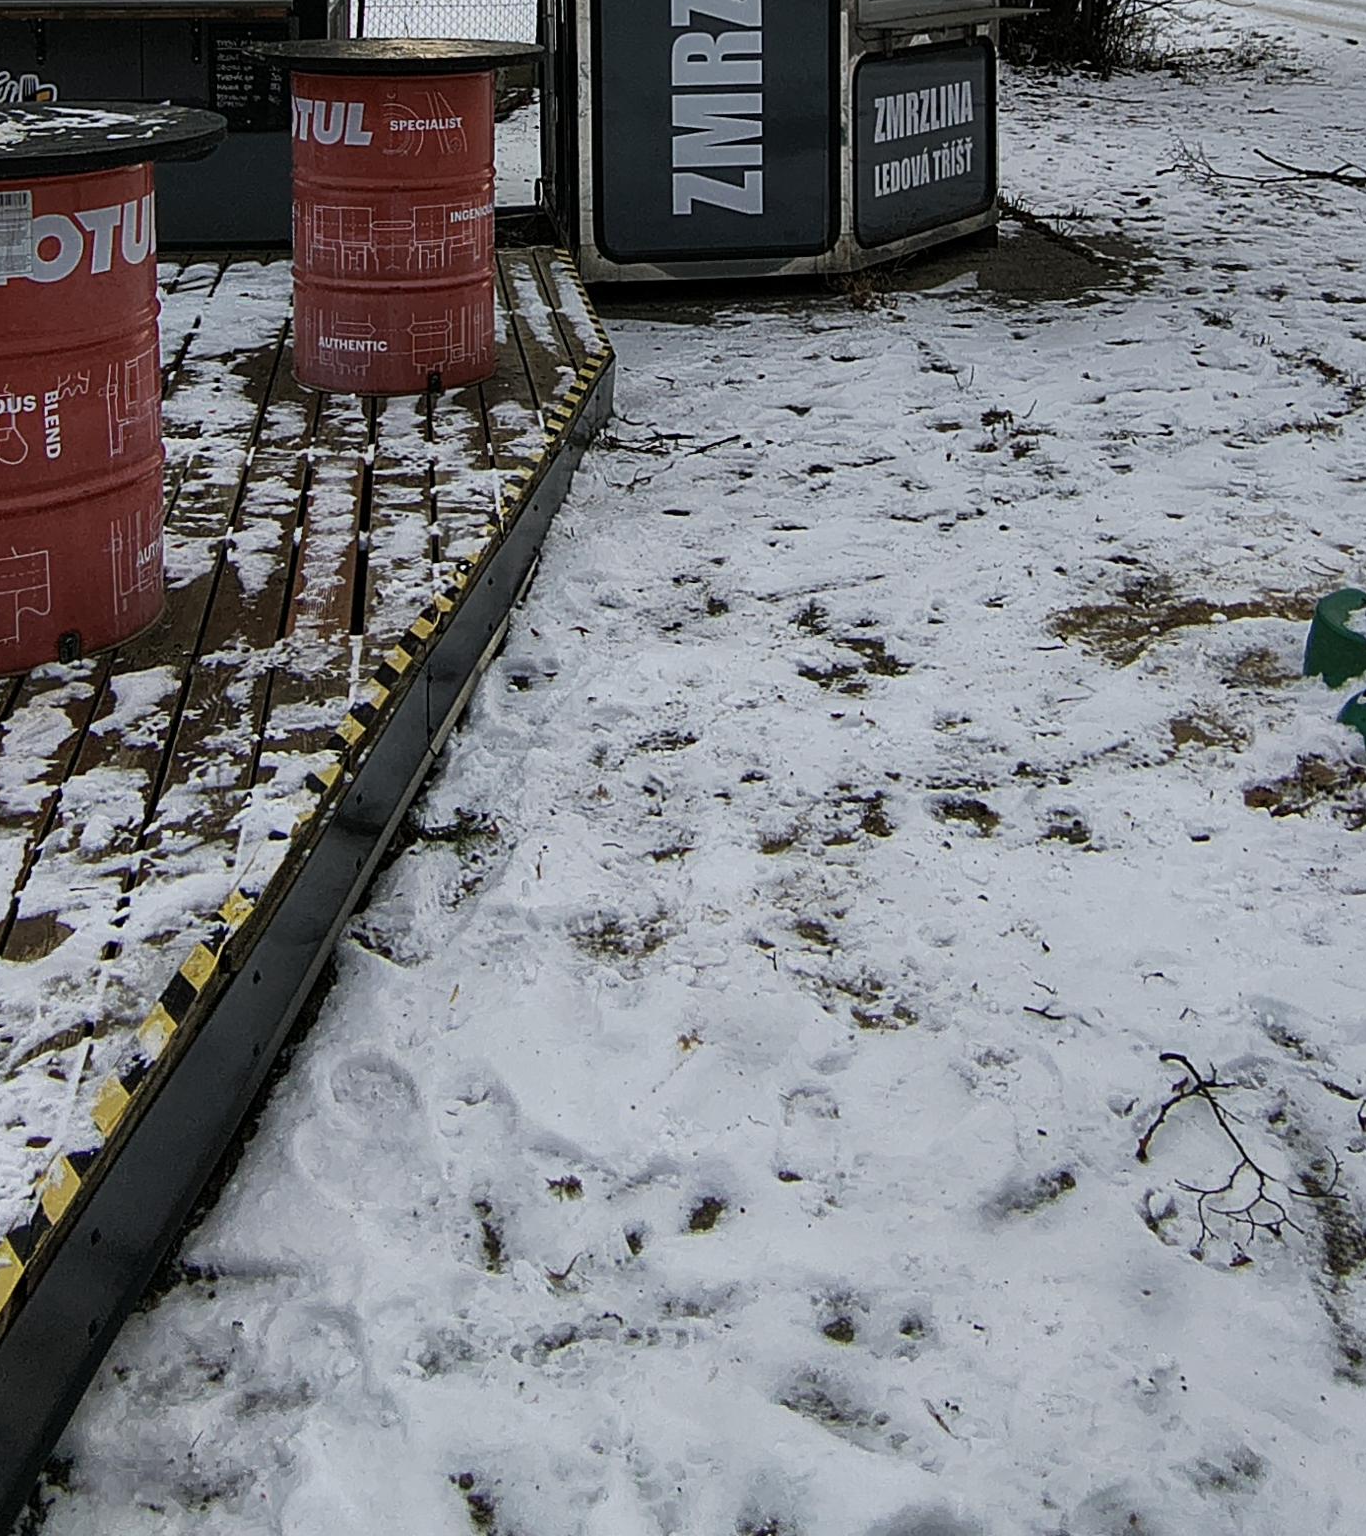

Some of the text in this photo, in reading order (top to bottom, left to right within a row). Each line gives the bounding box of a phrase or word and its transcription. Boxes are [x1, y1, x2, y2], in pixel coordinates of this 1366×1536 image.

[390, 115, 463, 131] SPECIALIST
[874, 80, 973, 143] ZMRZLINA
[875, 136, 973, 198] LEDOVÁ TŘÍŠŤ
[318, 337, 389, 352] AUTHENTIC
[42, 390, 61, 460] BLEND
